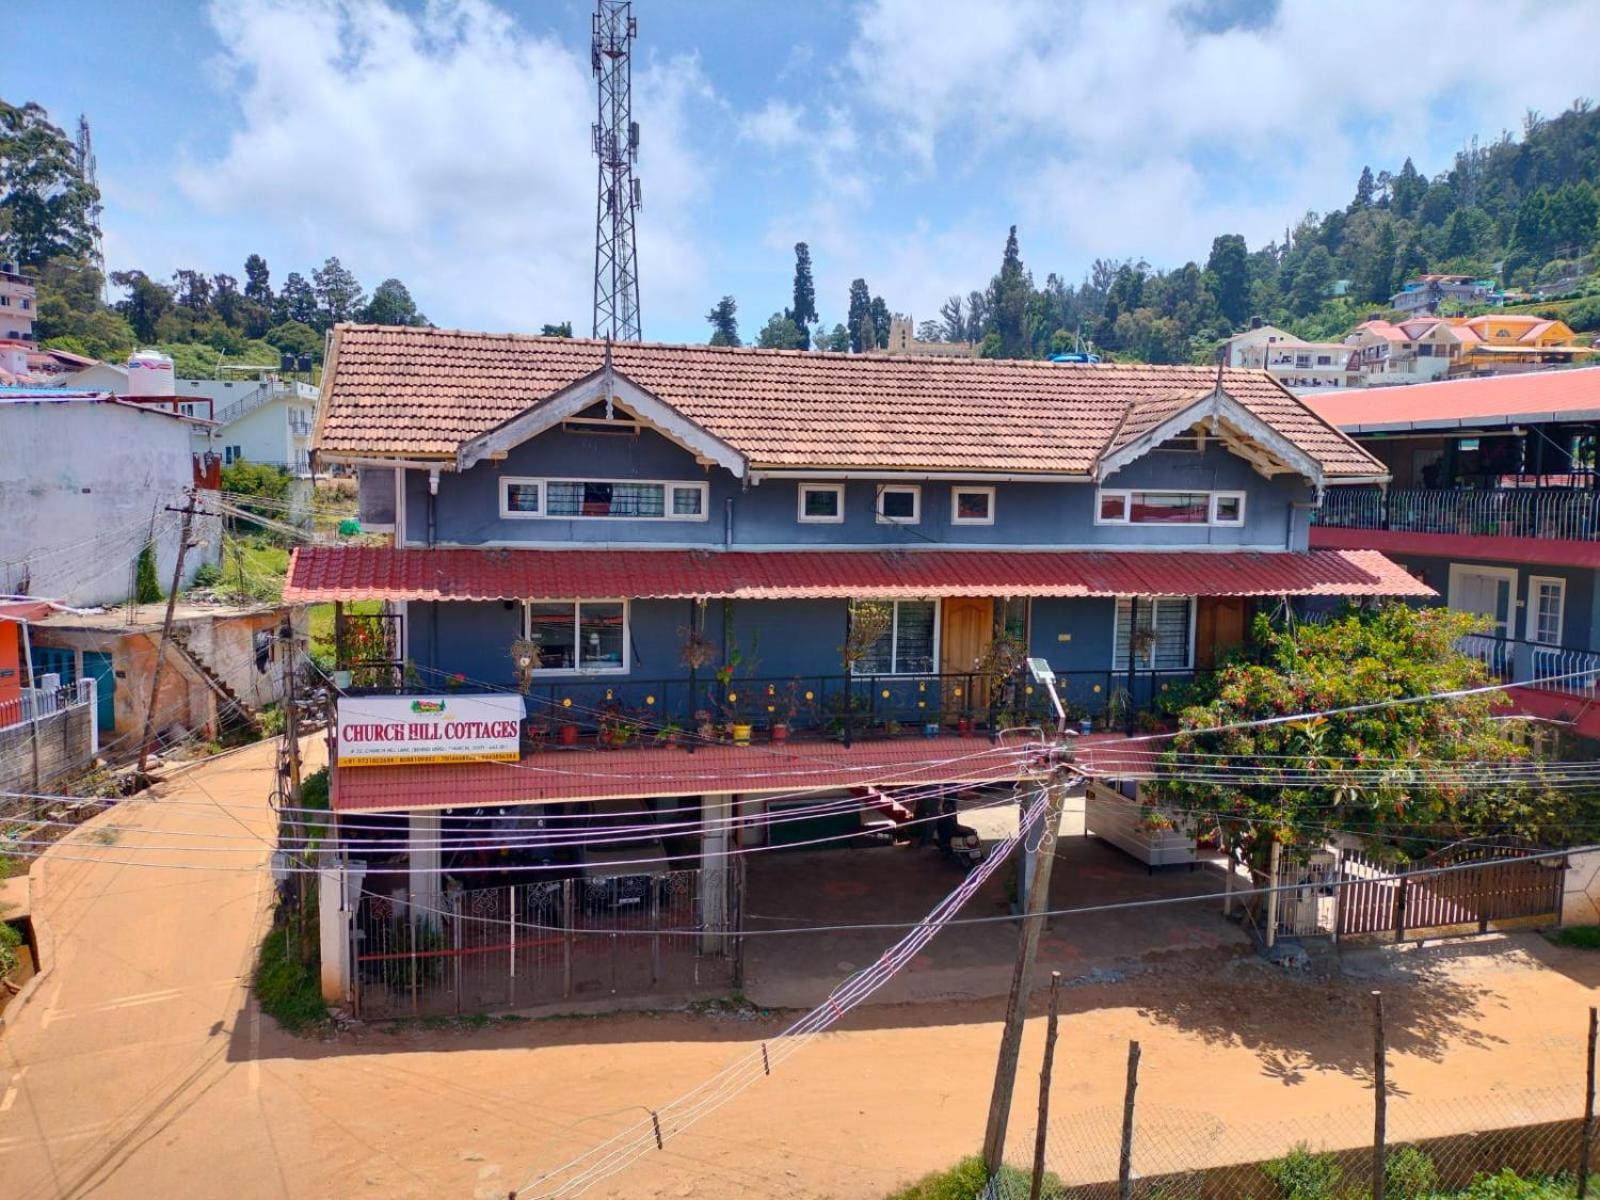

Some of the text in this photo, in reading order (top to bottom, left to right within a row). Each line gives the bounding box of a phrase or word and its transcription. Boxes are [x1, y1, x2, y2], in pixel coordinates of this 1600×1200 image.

[343, 720, 517, 742] CHURCH HILL COTTAGES
